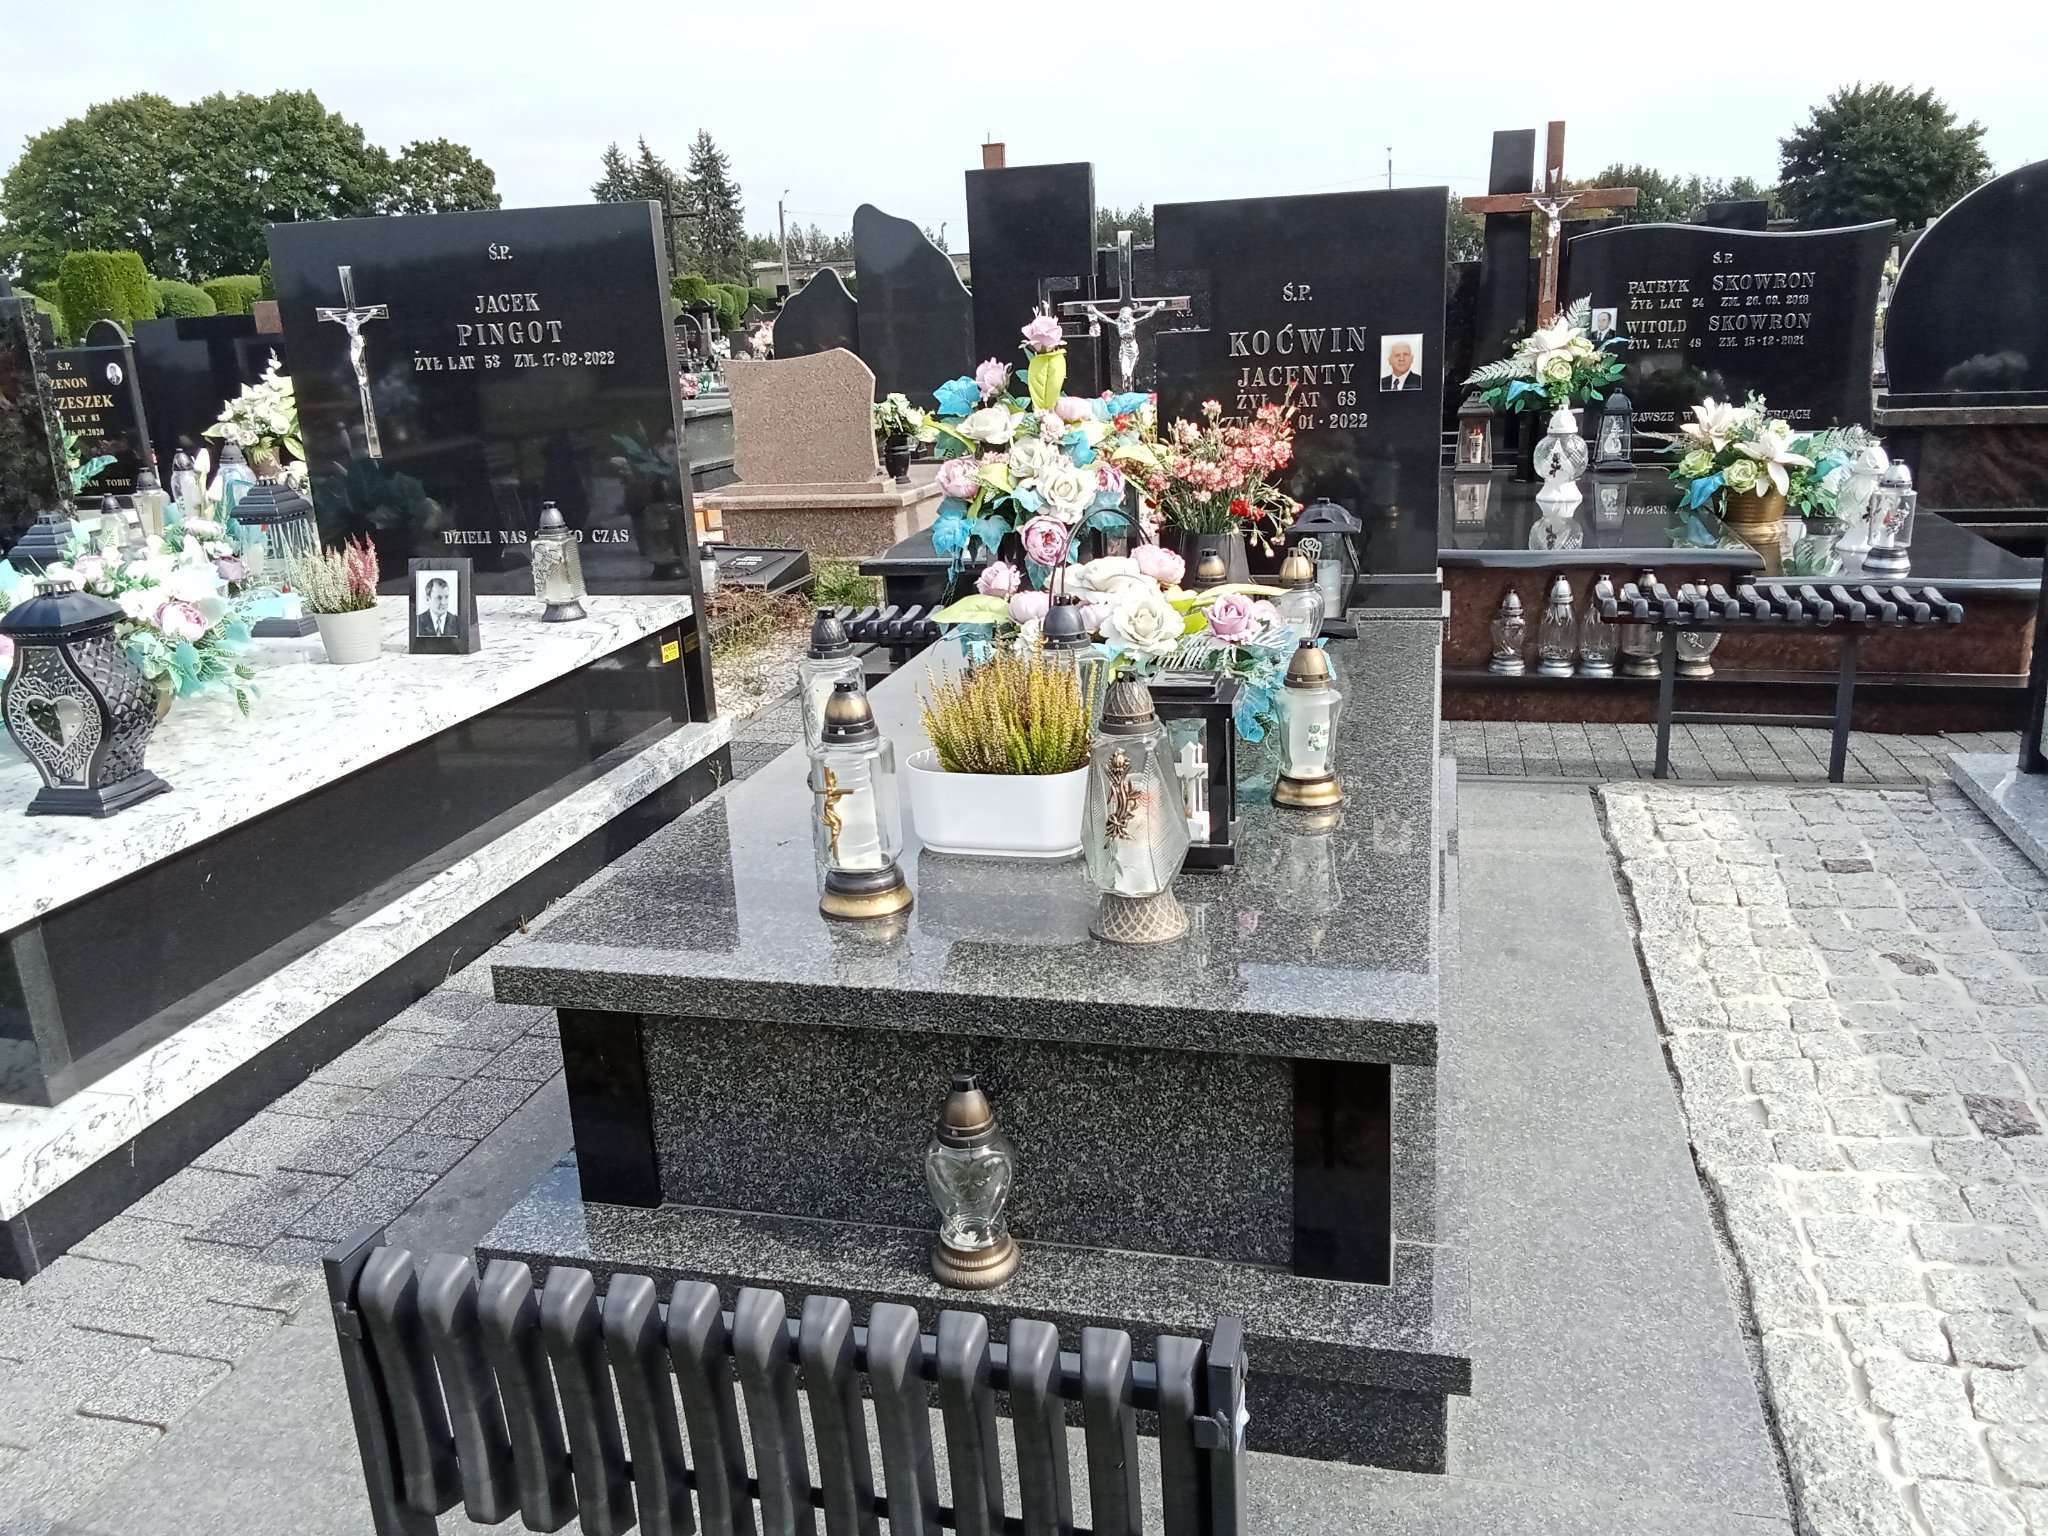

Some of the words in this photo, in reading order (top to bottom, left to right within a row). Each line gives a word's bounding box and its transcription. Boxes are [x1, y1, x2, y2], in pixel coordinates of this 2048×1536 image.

[487, 243, 514, 261] Ś.P.
[1712, 251, 1734, 264] Ś.P.
[1282, 281, 1314, 302] Ś.P.
[1627, 279, 1691, 295] PATRYK
[1712, 272, 1817, 292] SKOWRON
[474, 293, 541, 315] JACEK
[1659, 298, 1684, 309] LAT
[1625, 319, 1688, 334] WITOLD
[1708, 312, 1813, 332] SKOWRON
[456, 320, 564, 347] PINGOT
[1228, 323, 1368, 357] KOĆWIN
[1657, 338, 1681, 349] LAT
[447, 355, 477, 371] LAT
[483, 353, 502, 369] 53
[49, 377, 88, 390] ZENON
[1237, 363, 1355, 388] JACENTY
[53, 394, 115, 410] ZESZEK
[1284, 391, 1321, 408] LAT
[1336, 390, 1358, 406] 68
[70, 414, 87, 423] LAT
[1631, 411, 1675, 423] ZAWSZE
[1682, 411, 1694, 421] W
[1766, 409, 1812, 420] ERCACH
[105, 478, 132, 487] TOBIE
[442, 529, 492, 545] DZIELI
[498, 530, 528, 544] NAS
[591, 529, 630, 543] CZAS
